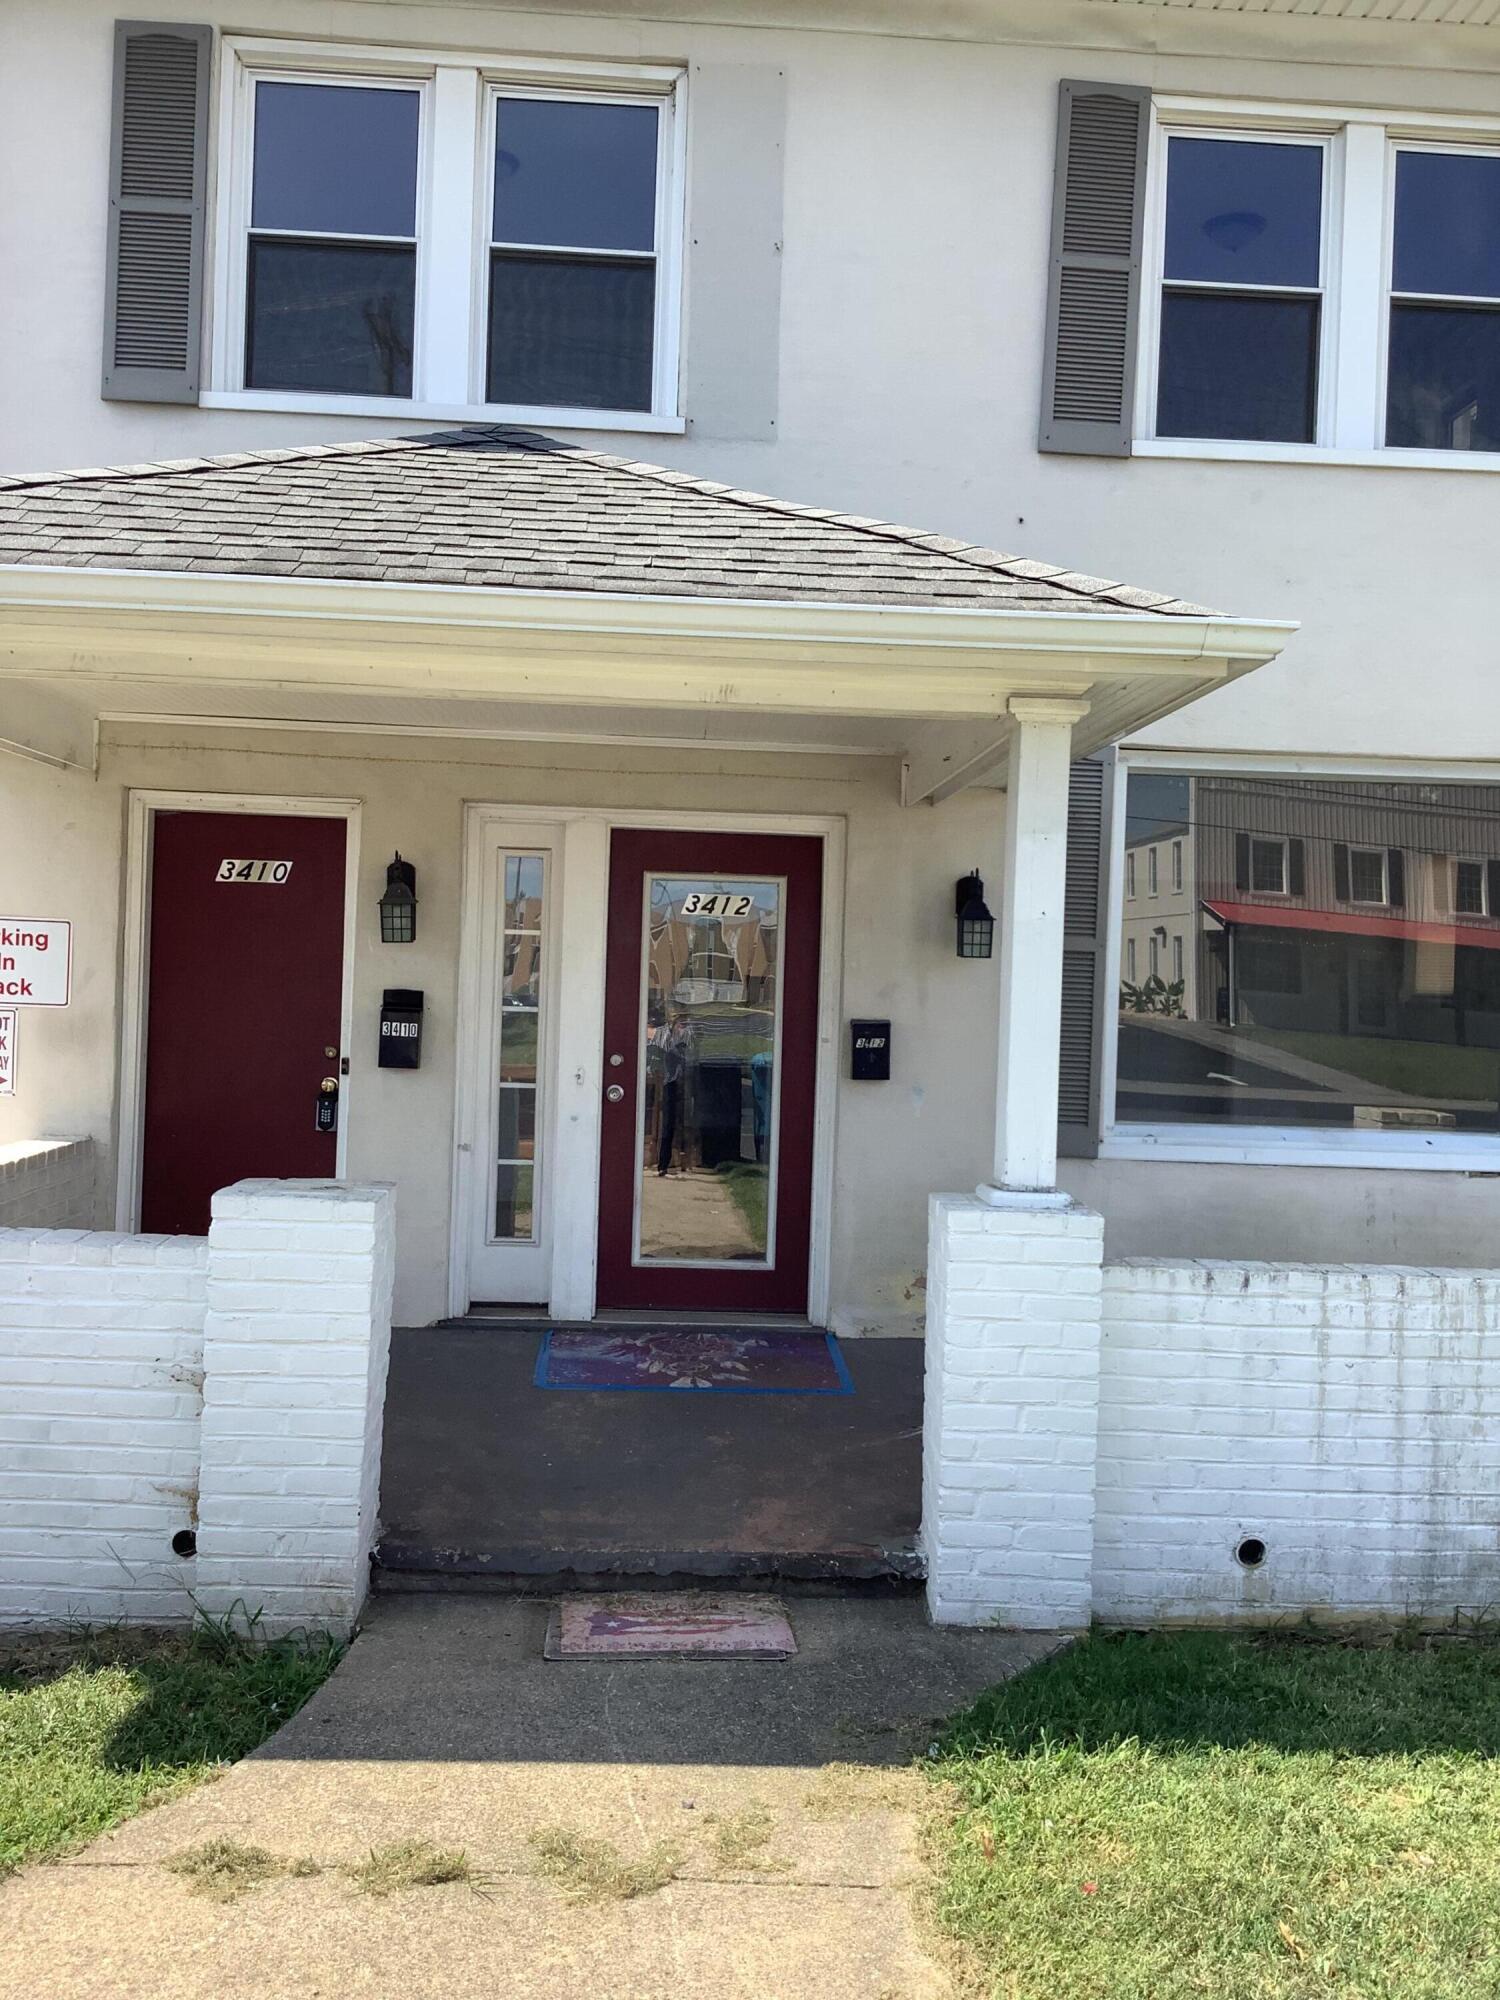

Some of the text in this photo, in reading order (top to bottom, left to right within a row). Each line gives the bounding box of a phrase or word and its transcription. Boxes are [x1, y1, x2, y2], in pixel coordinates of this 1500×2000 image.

[220, 861, 288, 882] 3410
[685, 895, 751, 915] 3412
[0, 927, 49, 951] king
[382, 1022, 418, 1037] 3410
